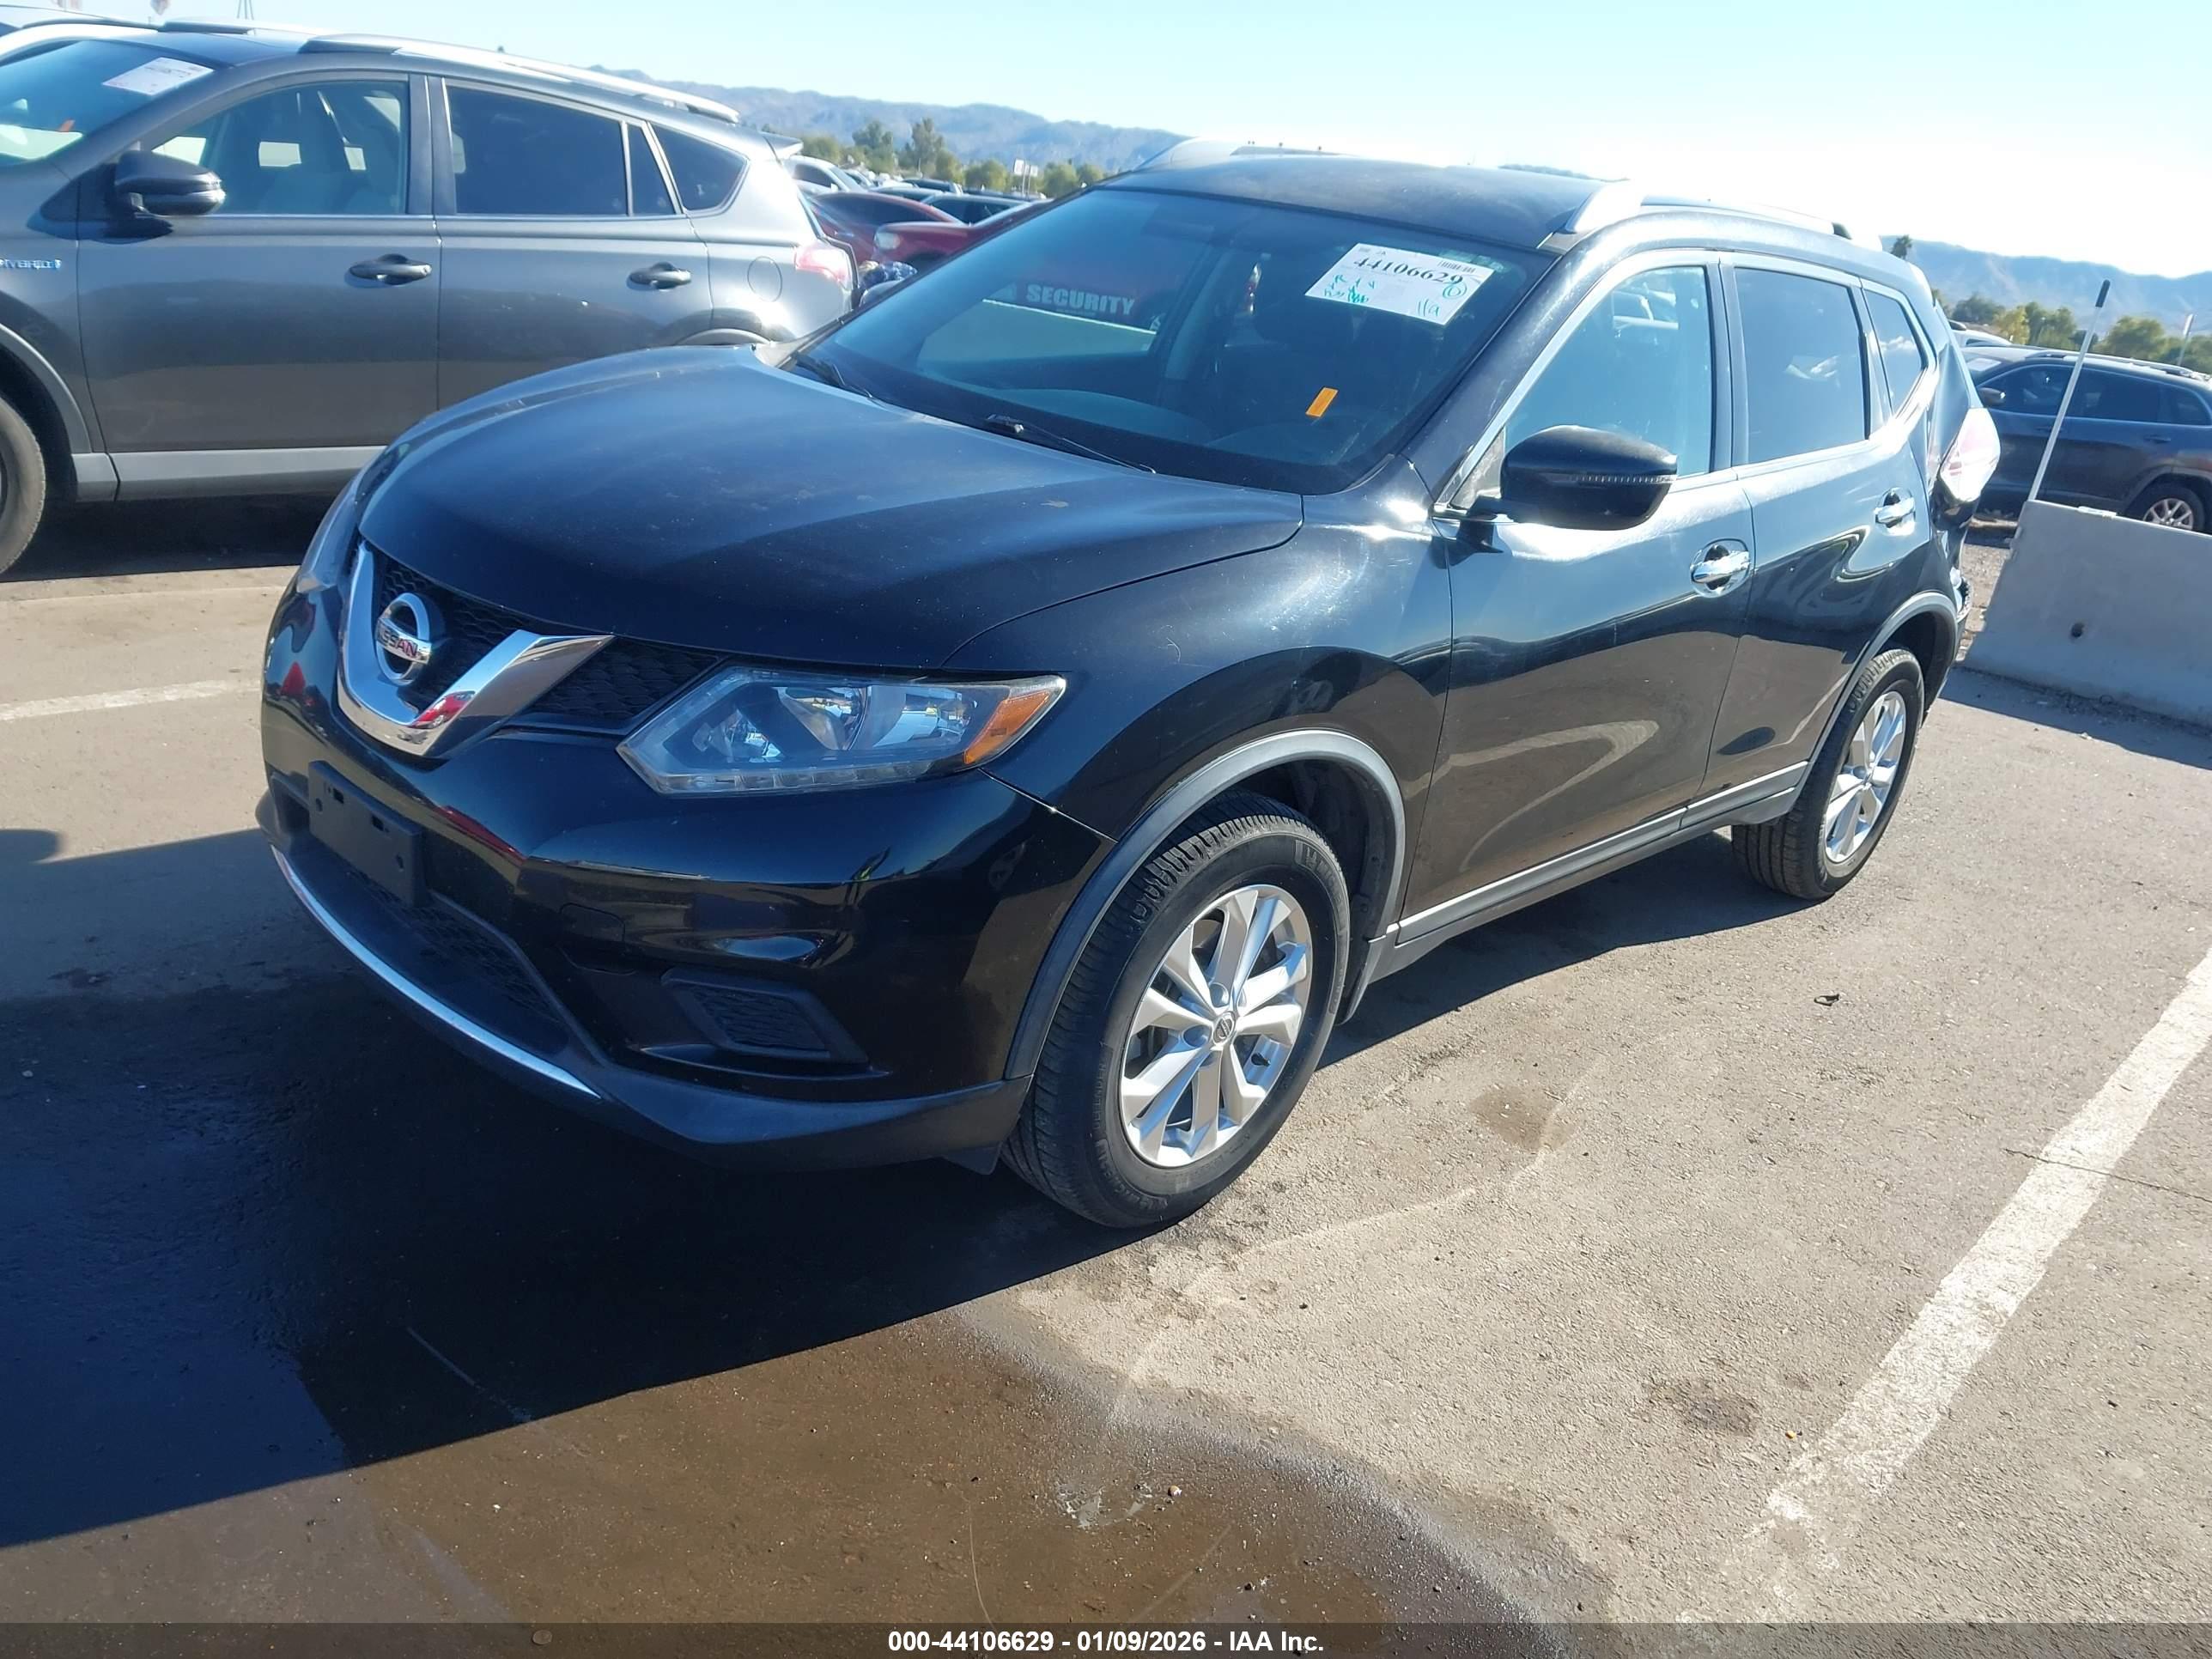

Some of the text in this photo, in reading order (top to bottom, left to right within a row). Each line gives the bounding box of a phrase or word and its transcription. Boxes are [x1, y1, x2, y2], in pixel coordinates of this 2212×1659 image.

[1354, 258, 1464, 286] 44106629
[1026, 284, 1135, 315] SECURITY
[377, 623, 418, 658] SSAN
